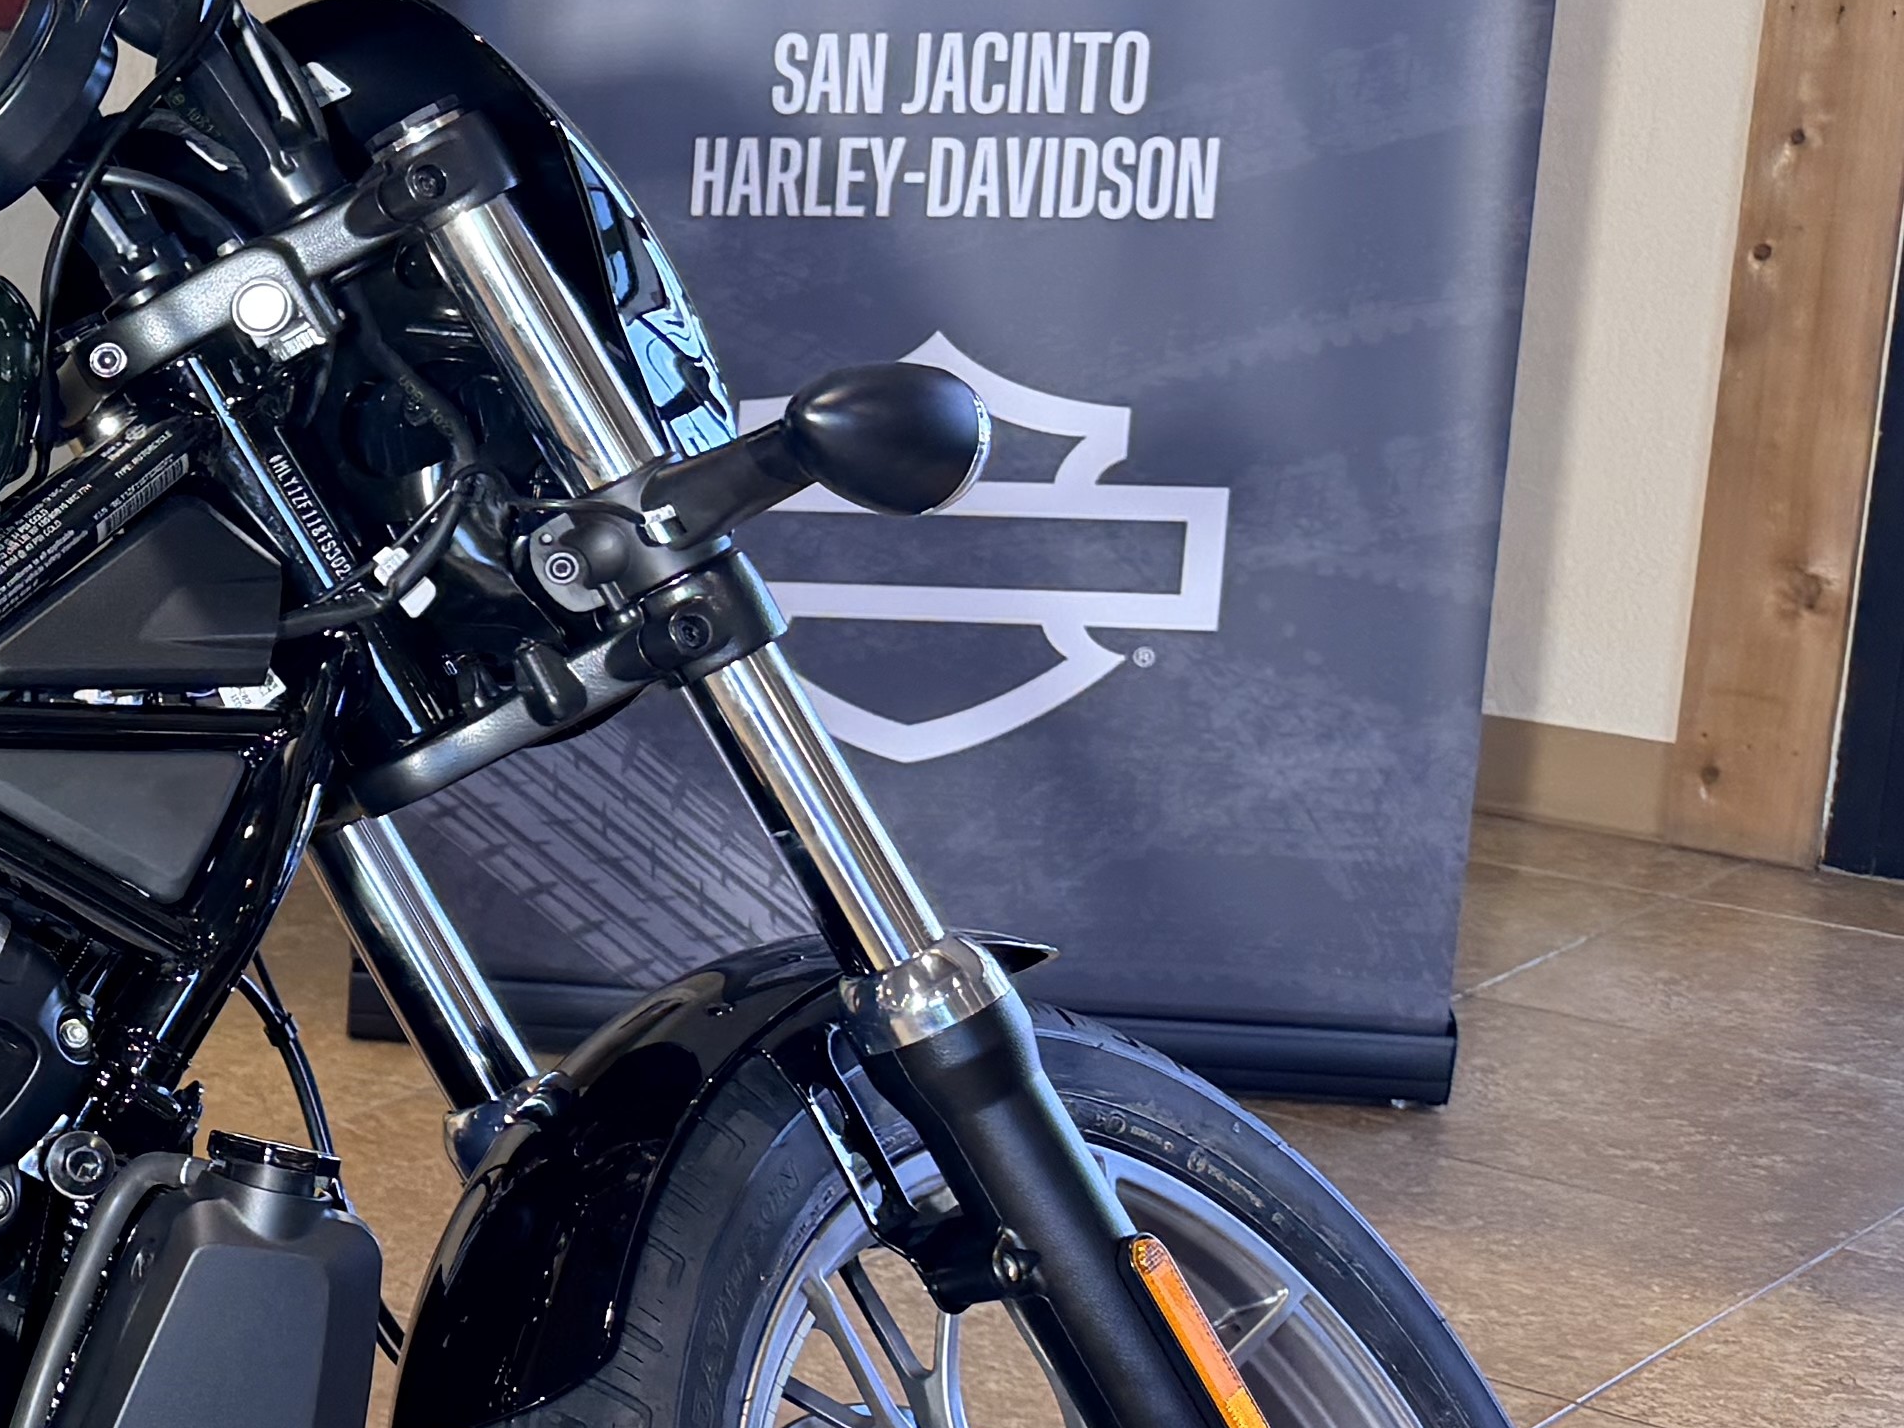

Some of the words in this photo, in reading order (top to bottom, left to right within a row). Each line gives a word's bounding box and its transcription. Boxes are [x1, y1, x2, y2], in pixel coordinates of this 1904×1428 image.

[771, 31, 888, 115] SAN
[900, 30, 1151, 116] JACINTO
[689, 137, 1221, 220] HARLEY-DAVIDSON
